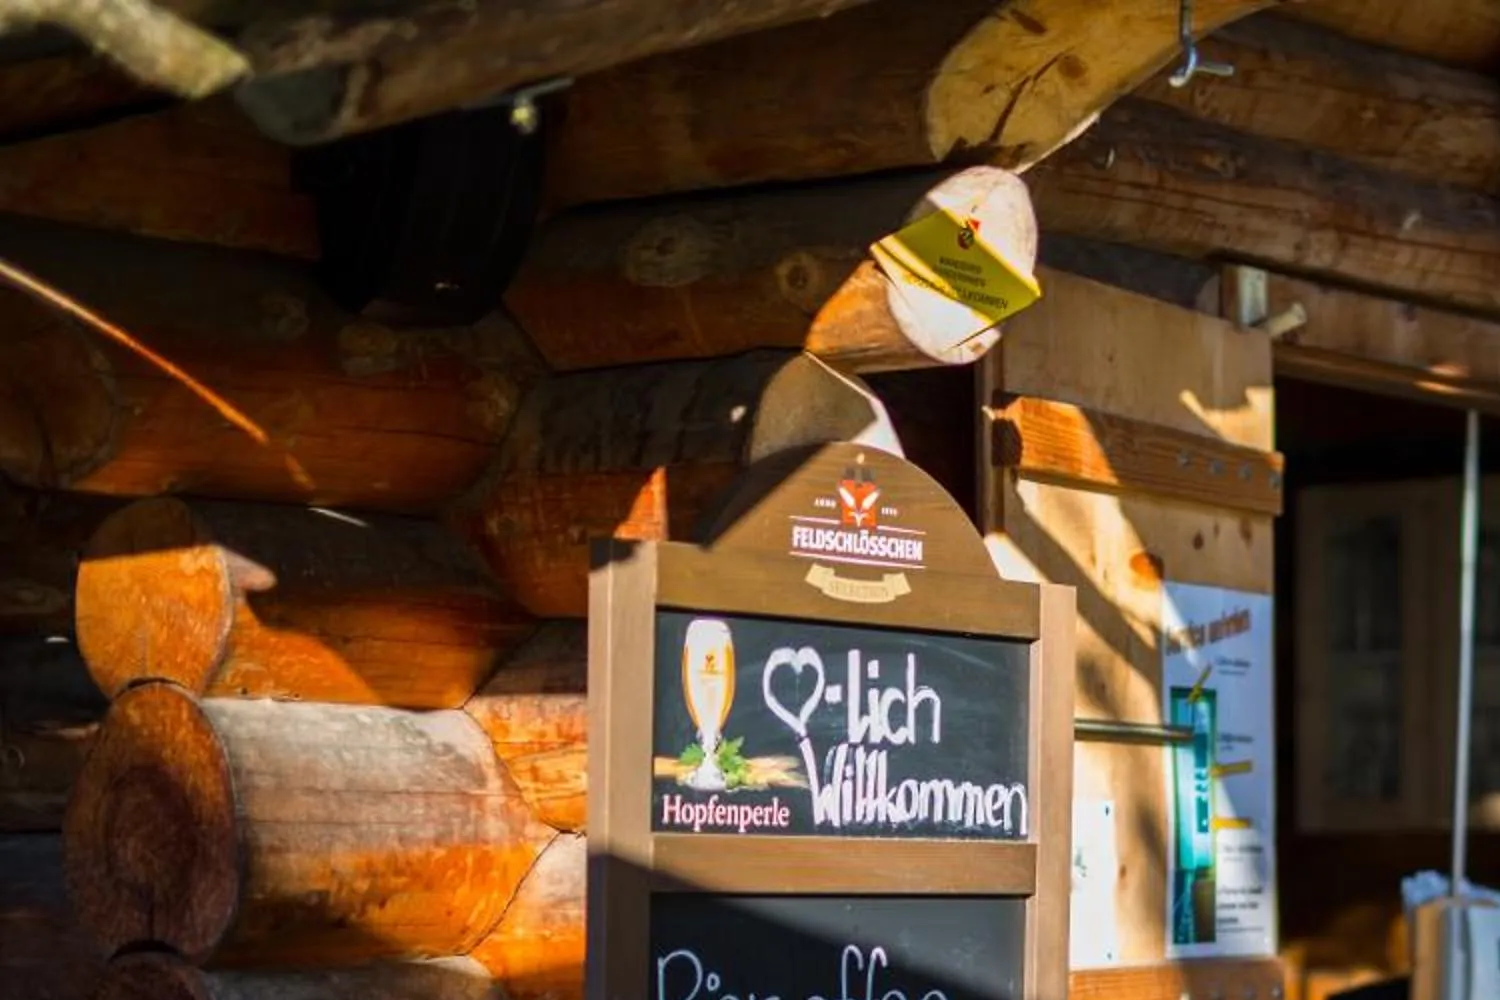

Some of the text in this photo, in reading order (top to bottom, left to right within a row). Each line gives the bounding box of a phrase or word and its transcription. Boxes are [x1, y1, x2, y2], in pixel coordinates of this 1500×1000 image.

[792, 525, 923, 561] FELDSCHLÖSSCHEN
[800, 736, 1028, 836] Willkommen
[662, 794, 790, 834] Hopfenperle
